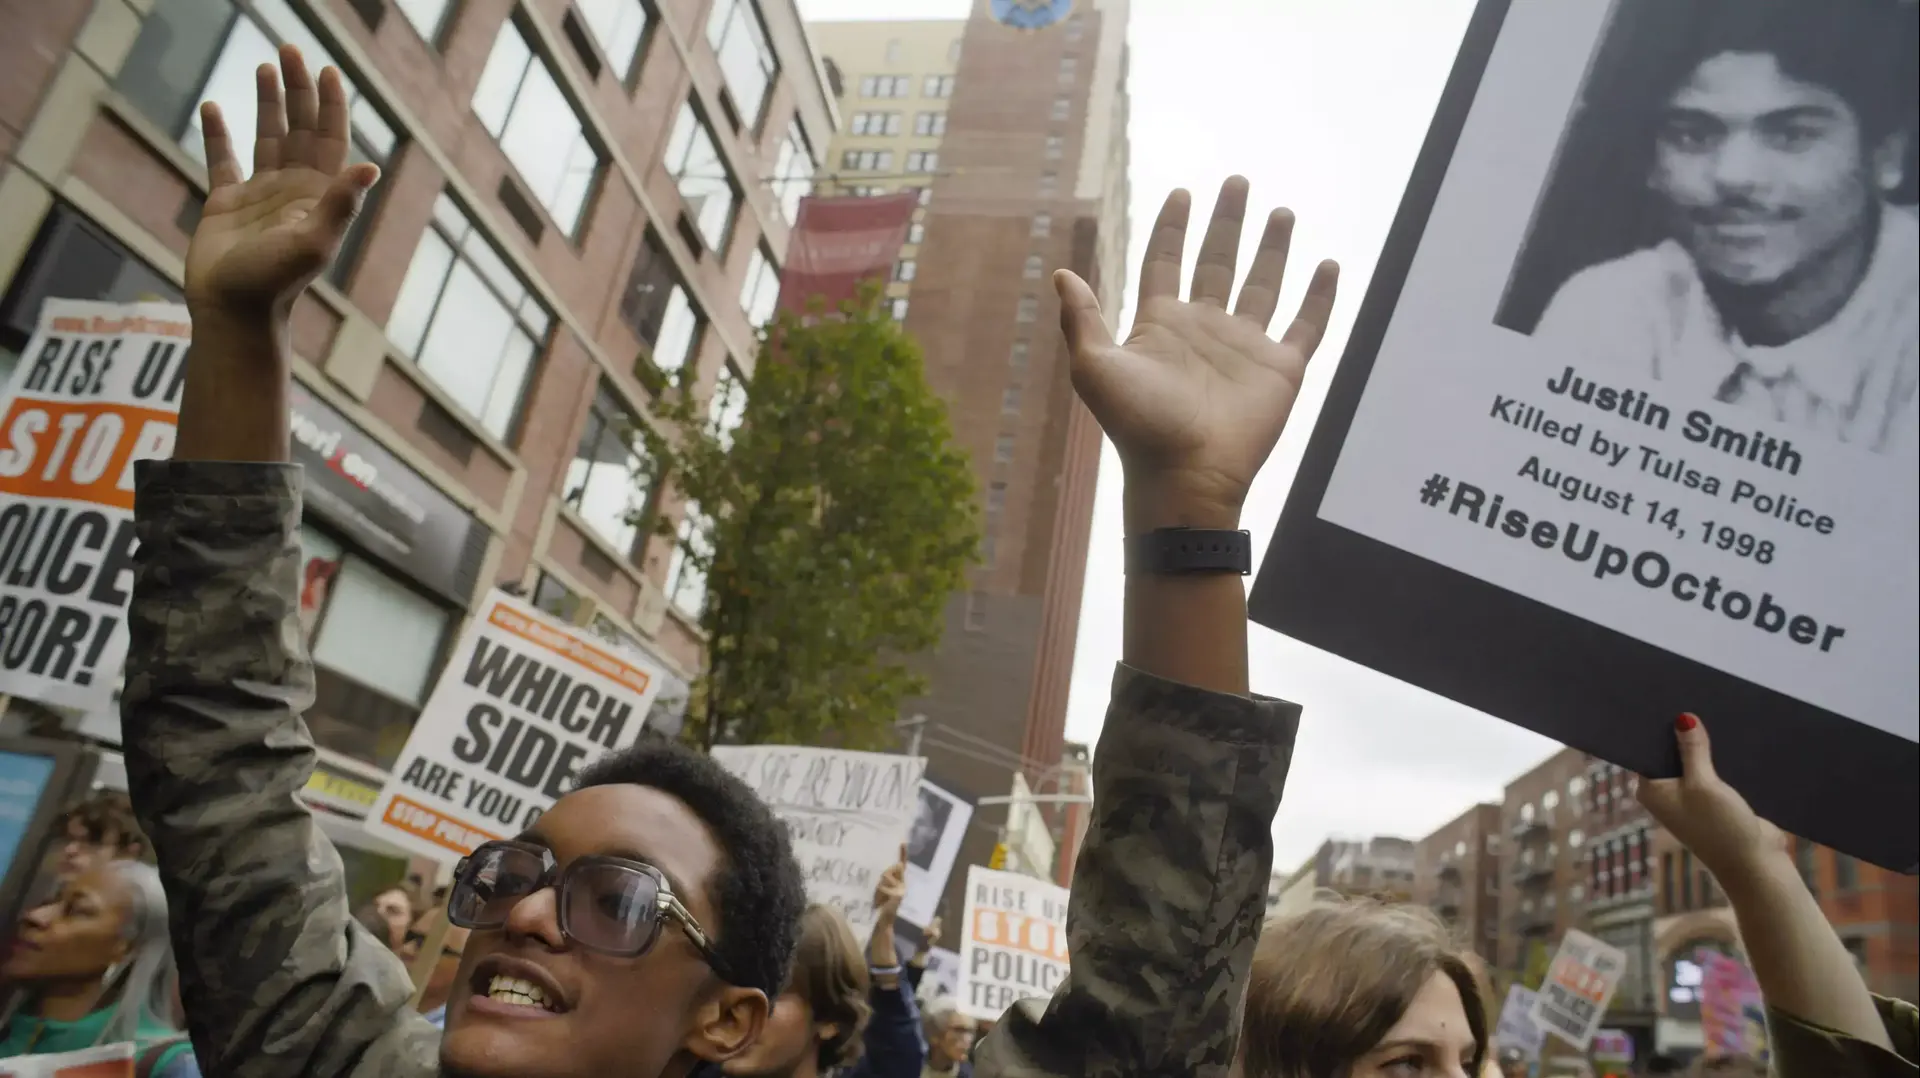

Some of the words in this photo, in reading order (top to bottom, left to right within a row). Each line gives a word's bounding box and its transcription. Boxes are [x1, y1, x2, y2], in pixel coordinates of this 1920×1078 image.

[25, 337, 124, 396] RISE
[1490, 395, 1582, 446] Killed
[1589, 430, 1629, 467] by
[1639, 445, 1720, 496] Tulsa
[1731, 480, 1835, 535] Police
[1547, 366, 1670, 430] Justin
[1682, 410, 1803, 476] Smith
[1420, 473, 1845, 653] #RiseUpOctober
[1517, 456, 1634, 515] August
[1646, 501, 1686, 539] 14,
[1701, 521, 1776, 566] 1998
[464, 636, 633, 749] WHICH
[402, 754, 464, 801] ARE
[464, 778, 522, 826] YOU
[452, 702, 589, 800] SIDE
[976, 883, 1025, 911] RISE
[971, 947, 1070, 994] POLIC
